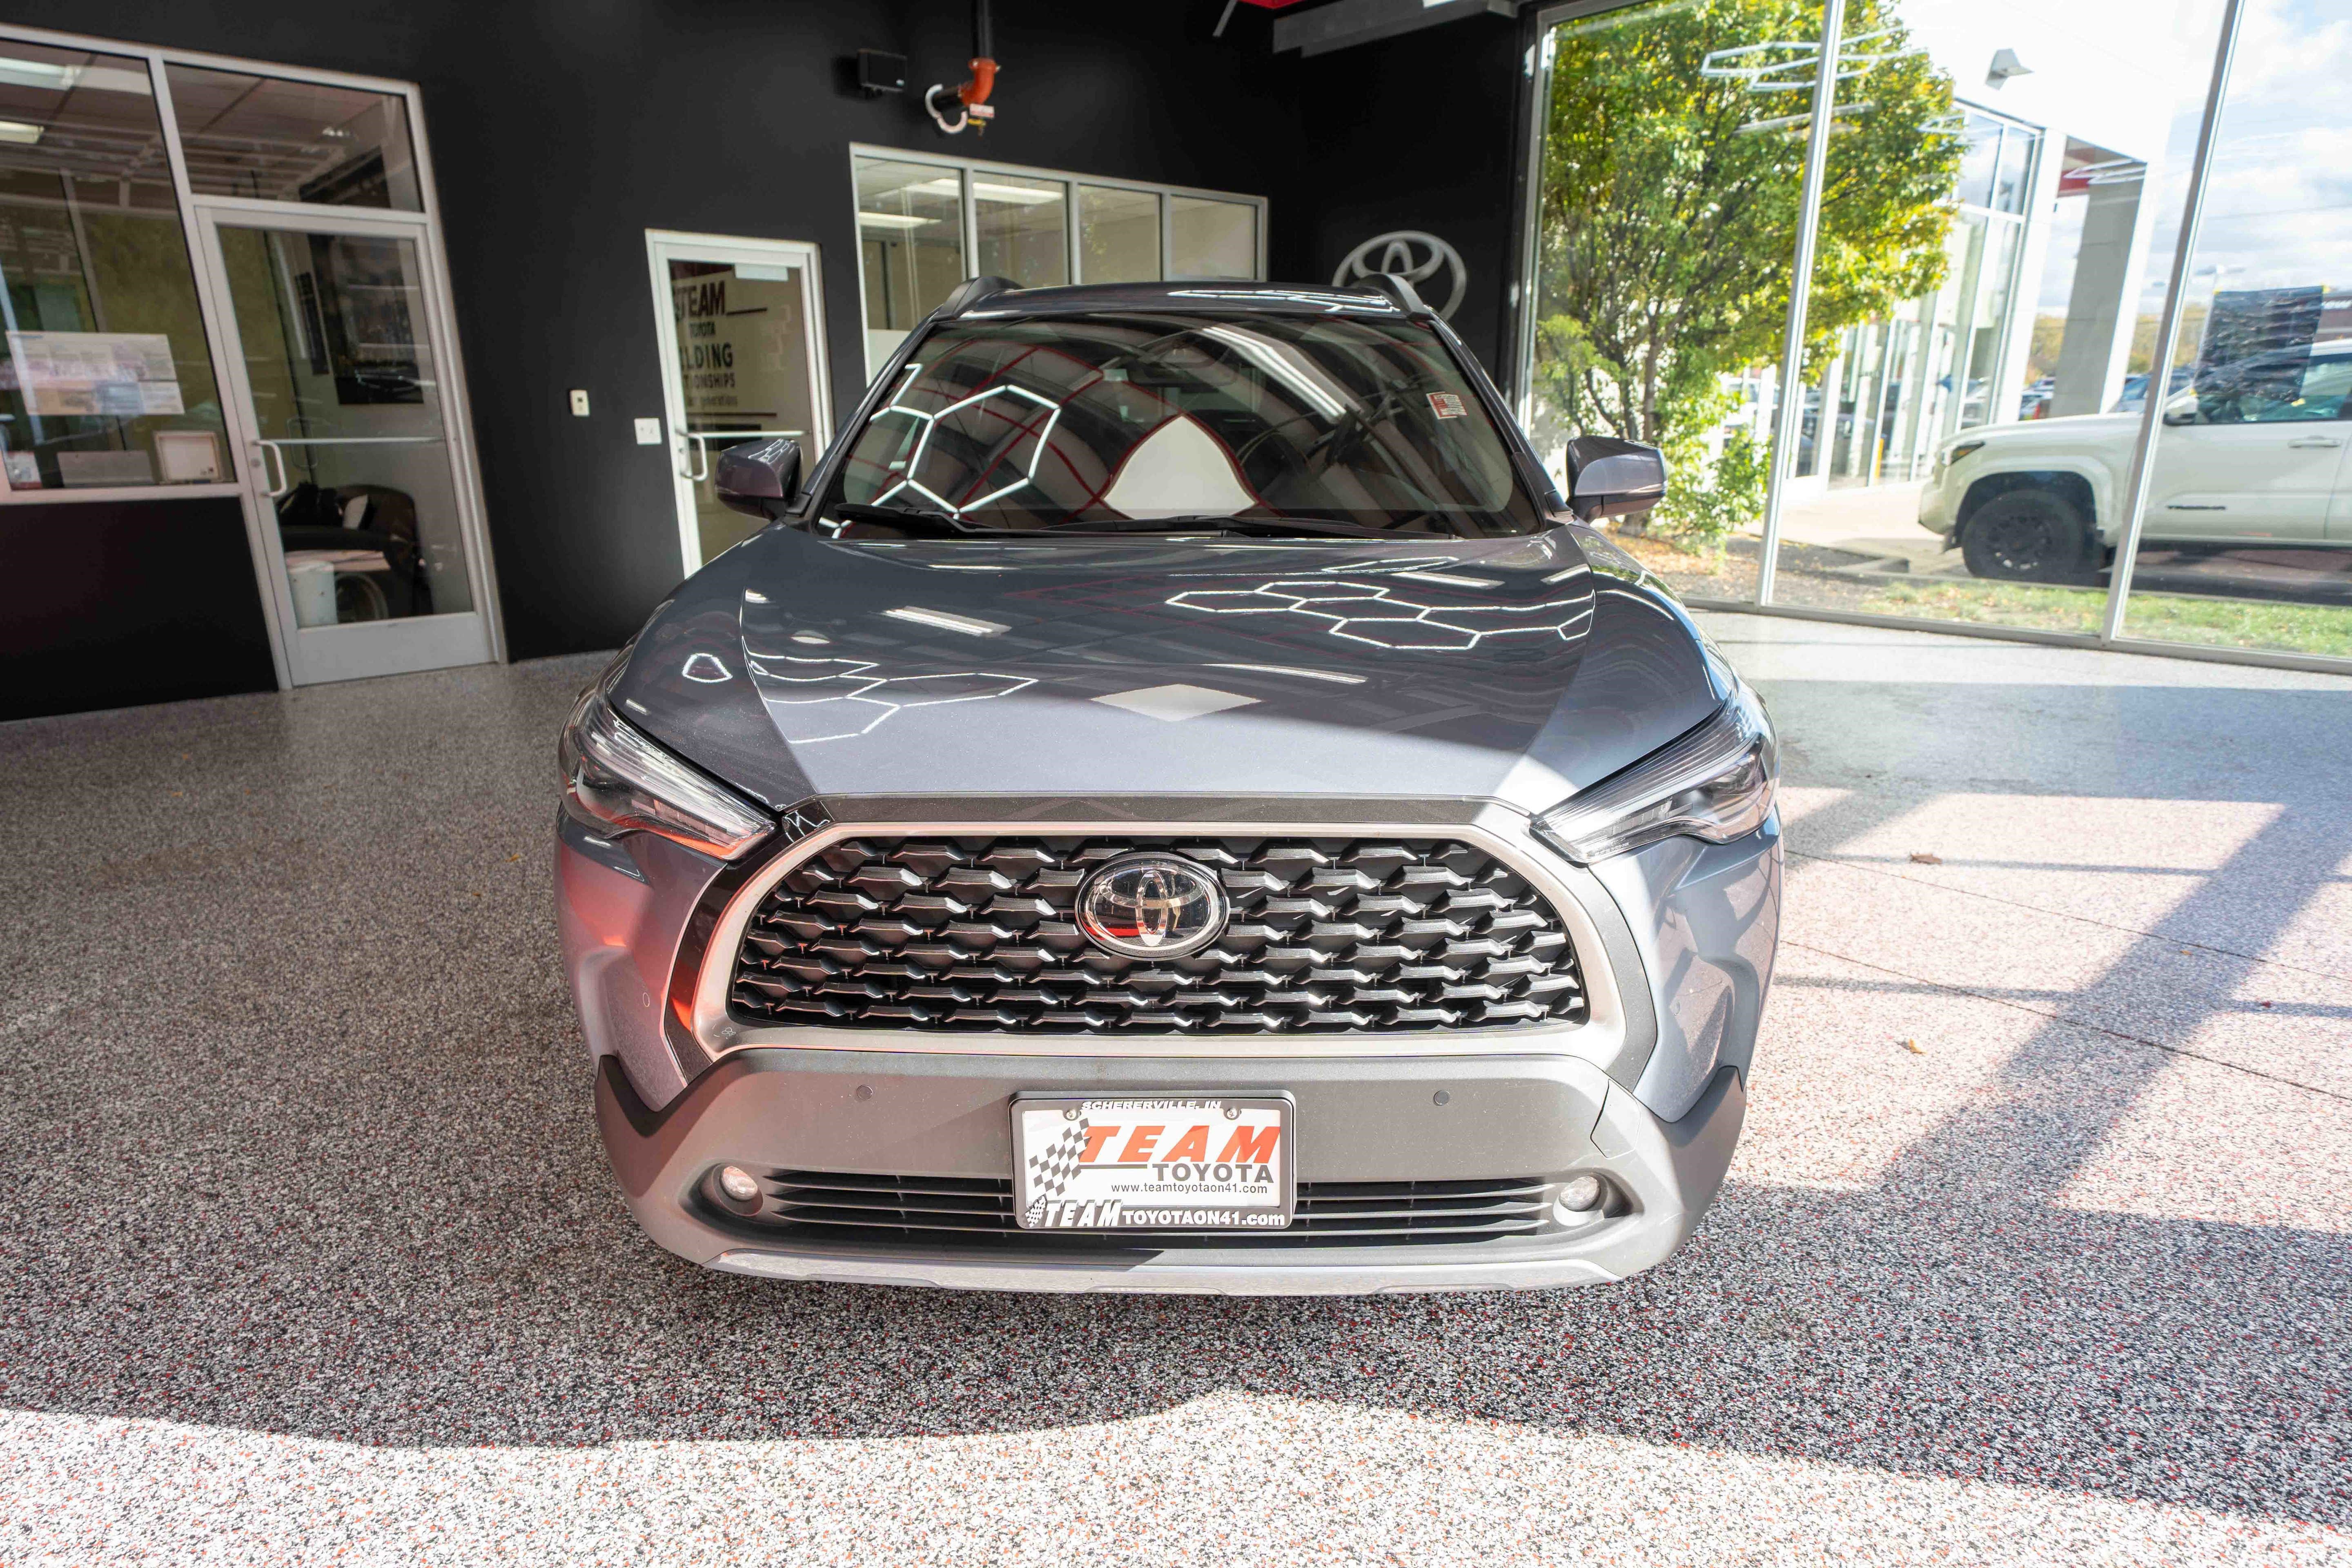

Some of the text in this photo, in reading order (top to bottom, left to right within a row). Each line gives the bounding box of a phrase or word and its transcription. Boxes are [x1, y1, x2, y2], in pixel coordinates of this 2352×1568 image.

[676, 280, 725, 316] TEAM
[1081, 1100, 1222, 1110] SCHERERVILLE, IN
[1079, 1125, 1280, 1164] TEAM
[1152, 1163, 1274, 1183] TOYOTA
[1111, 1183, 1267, 1194] www.teamtoyotaon41.com
[1044, 1200, 1285, 1227] TEAM TOYOTAON41.com
